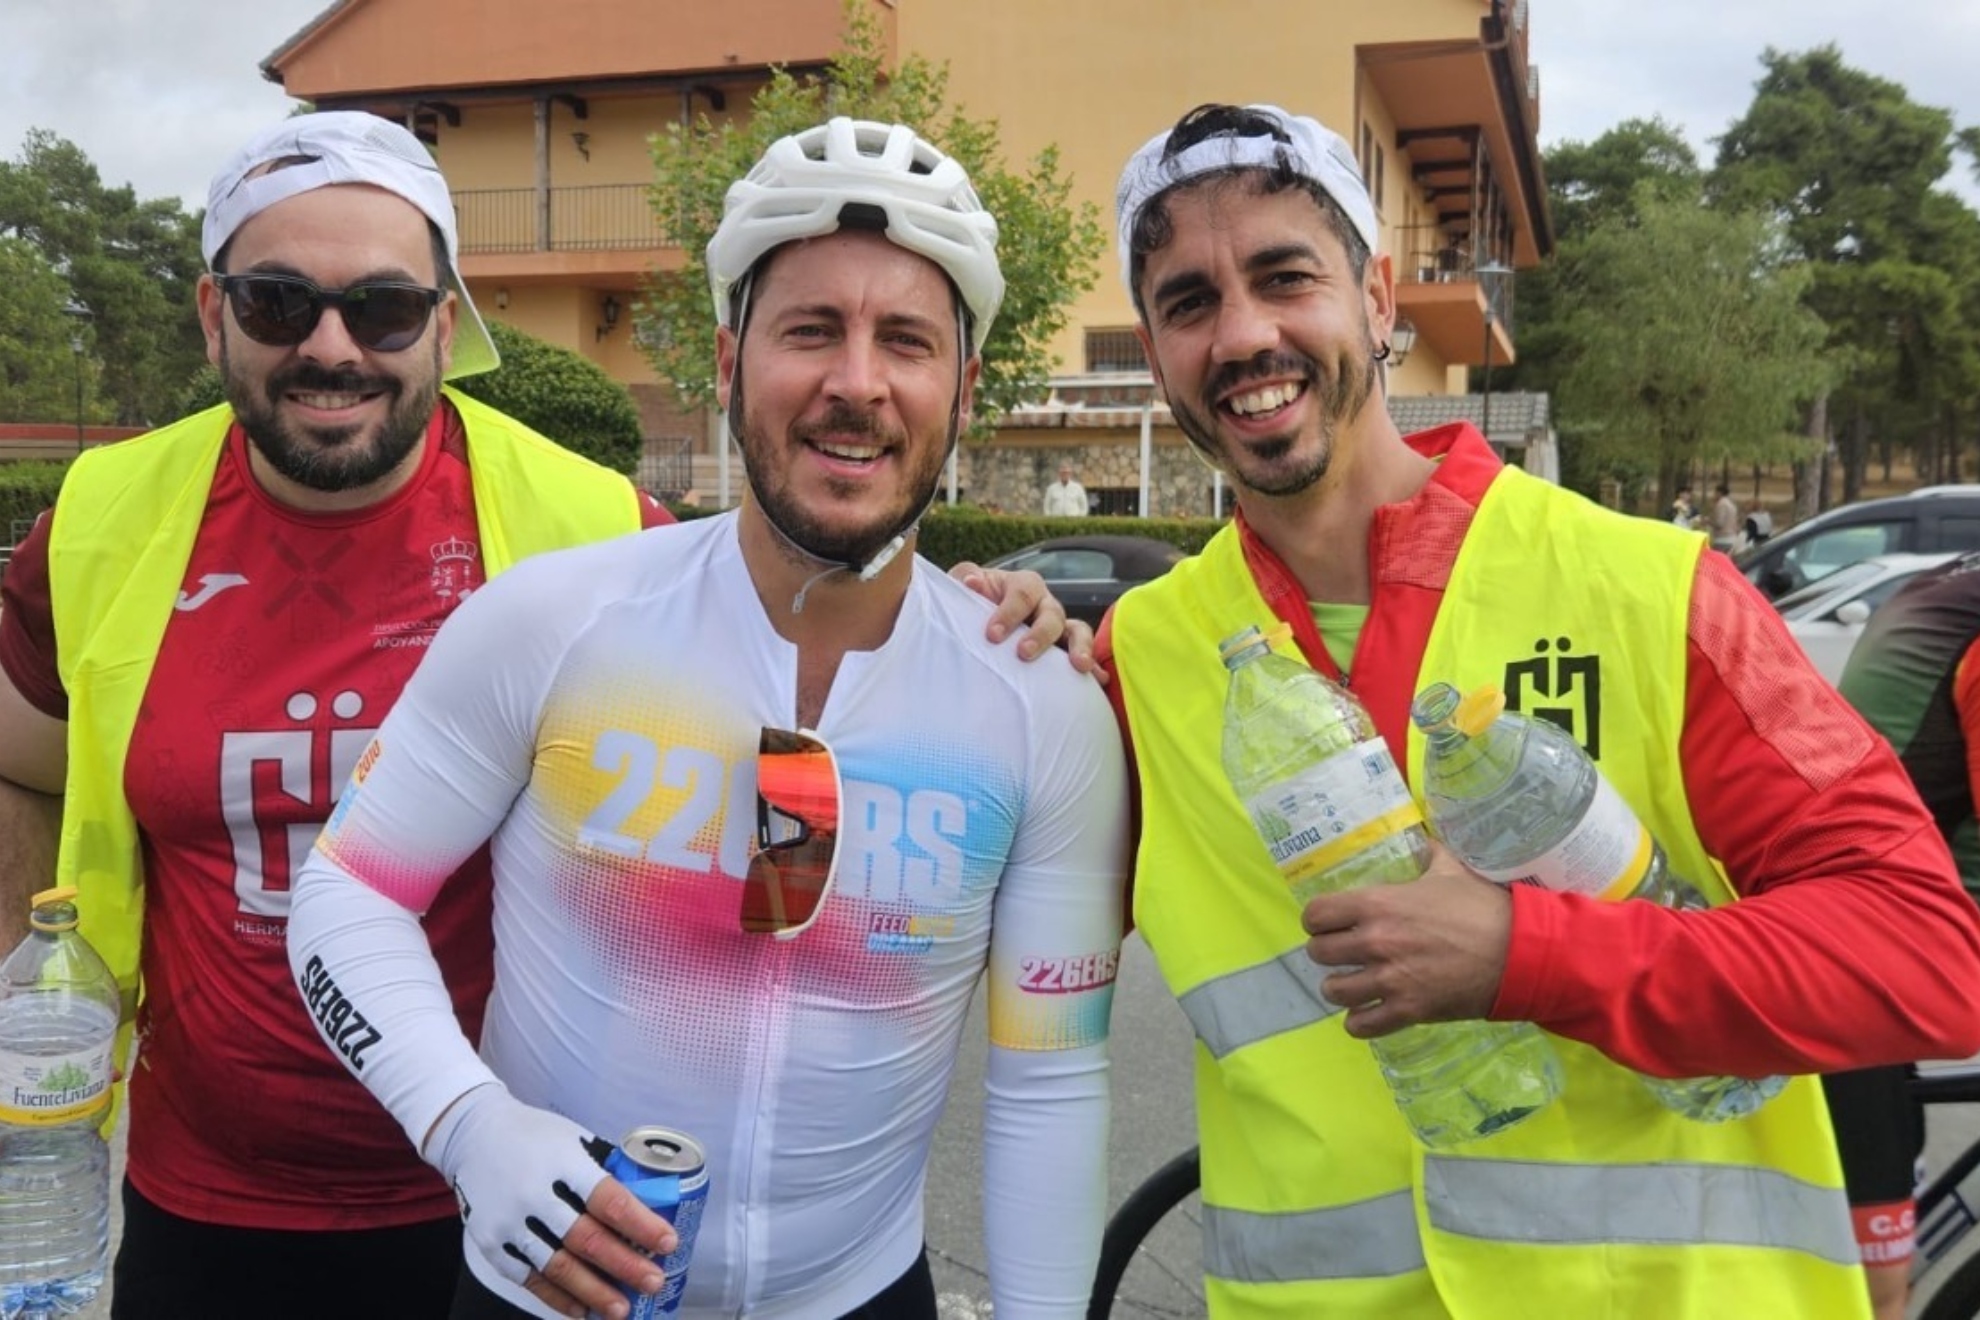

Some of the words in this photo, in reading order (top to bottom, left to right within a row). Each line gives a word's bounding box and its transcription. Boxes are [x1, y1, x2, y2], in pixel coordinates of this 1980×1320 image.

[870, 913, 909, 934] FEED
[1017, 949, 1119, 994] 226ERS
[301, 954, 383, 1072] 226ERS
